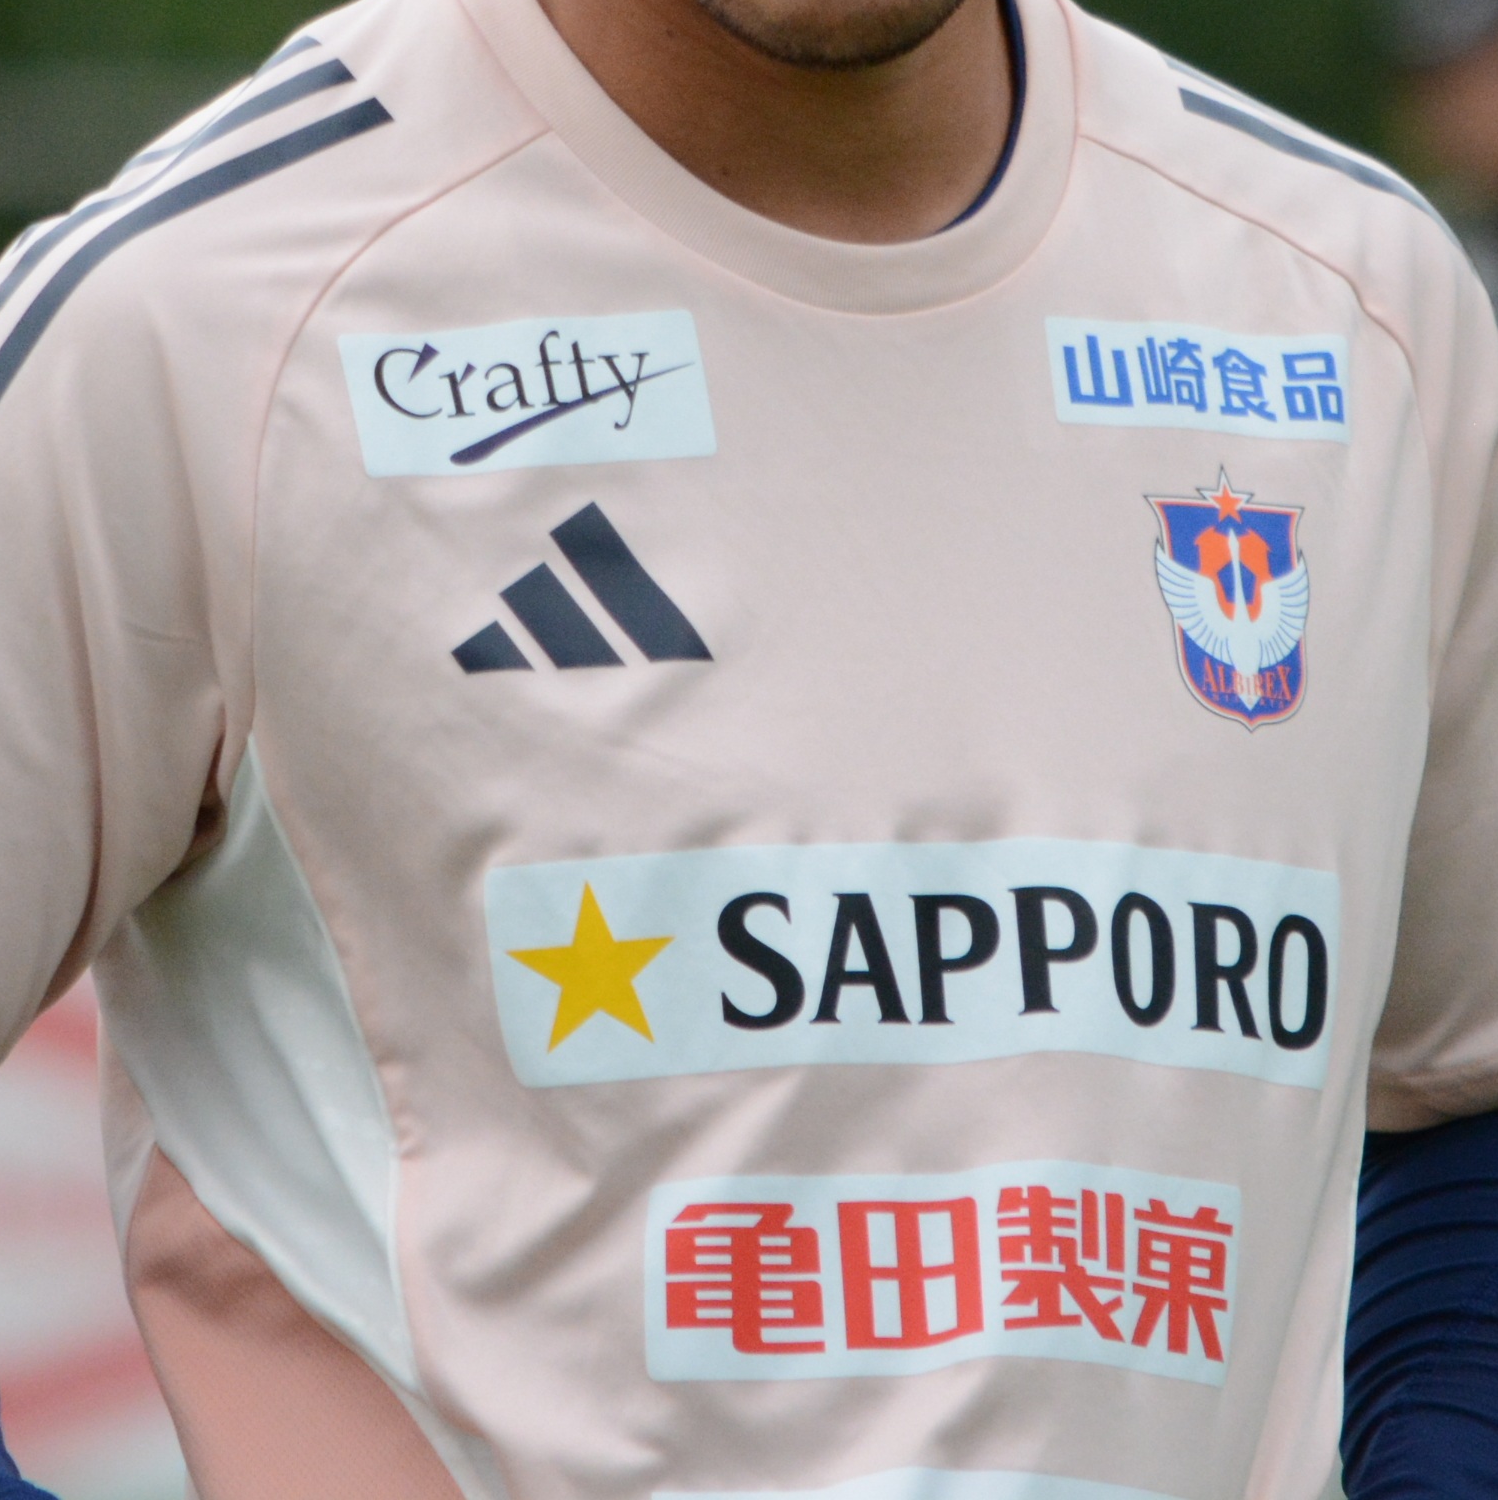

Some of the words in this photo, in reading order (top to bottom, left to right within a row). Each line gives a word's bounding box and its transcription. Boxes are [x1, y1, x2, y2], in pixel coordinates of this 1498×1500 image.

[372, 330, 648, 429] Crafty
[1062, 333, 1345, 424] 山崎食品
[1202, 656, 1292, 701] ALBIREX
[716, 886, 1328, 1050] SAPPORO
[664, 1185, 1235, 1363] 亀田製菓
